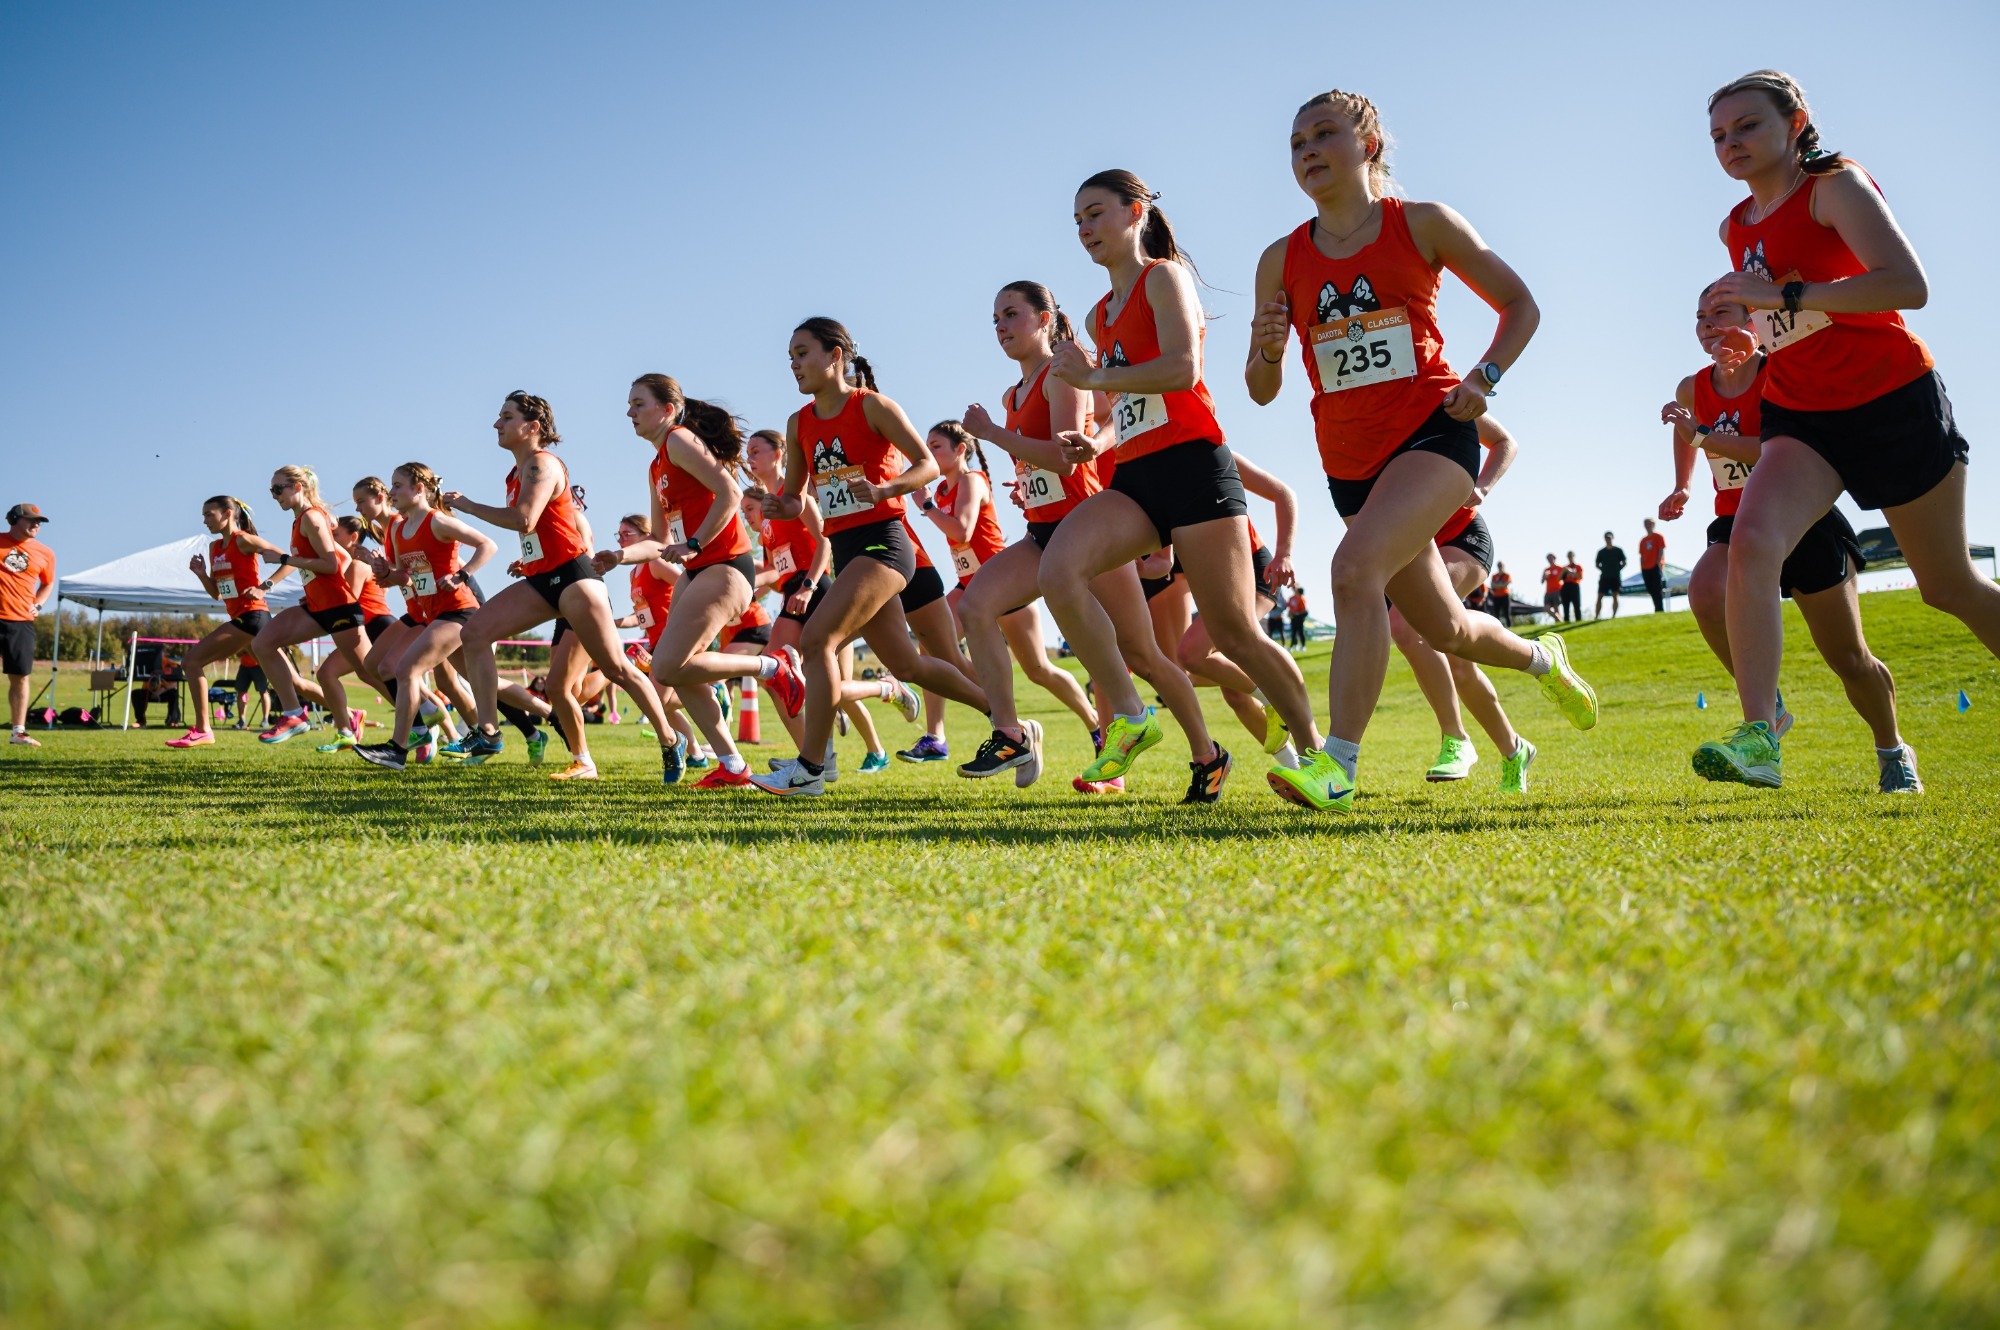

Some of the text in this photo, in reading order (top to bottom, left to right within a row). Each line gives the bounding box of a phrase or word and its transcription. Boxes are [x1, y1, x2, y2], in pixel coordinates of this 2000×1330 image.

[1317, 315, 1403, 341] DAKOTA CLASSIC
[1333, 339, 1392, 377] 235
[1117, 396, 1146, 432] 237
[826, 488, 855, 509] 241
[1022, 476, 1049, 499] 240
[522, 541, 534, 556] 19
